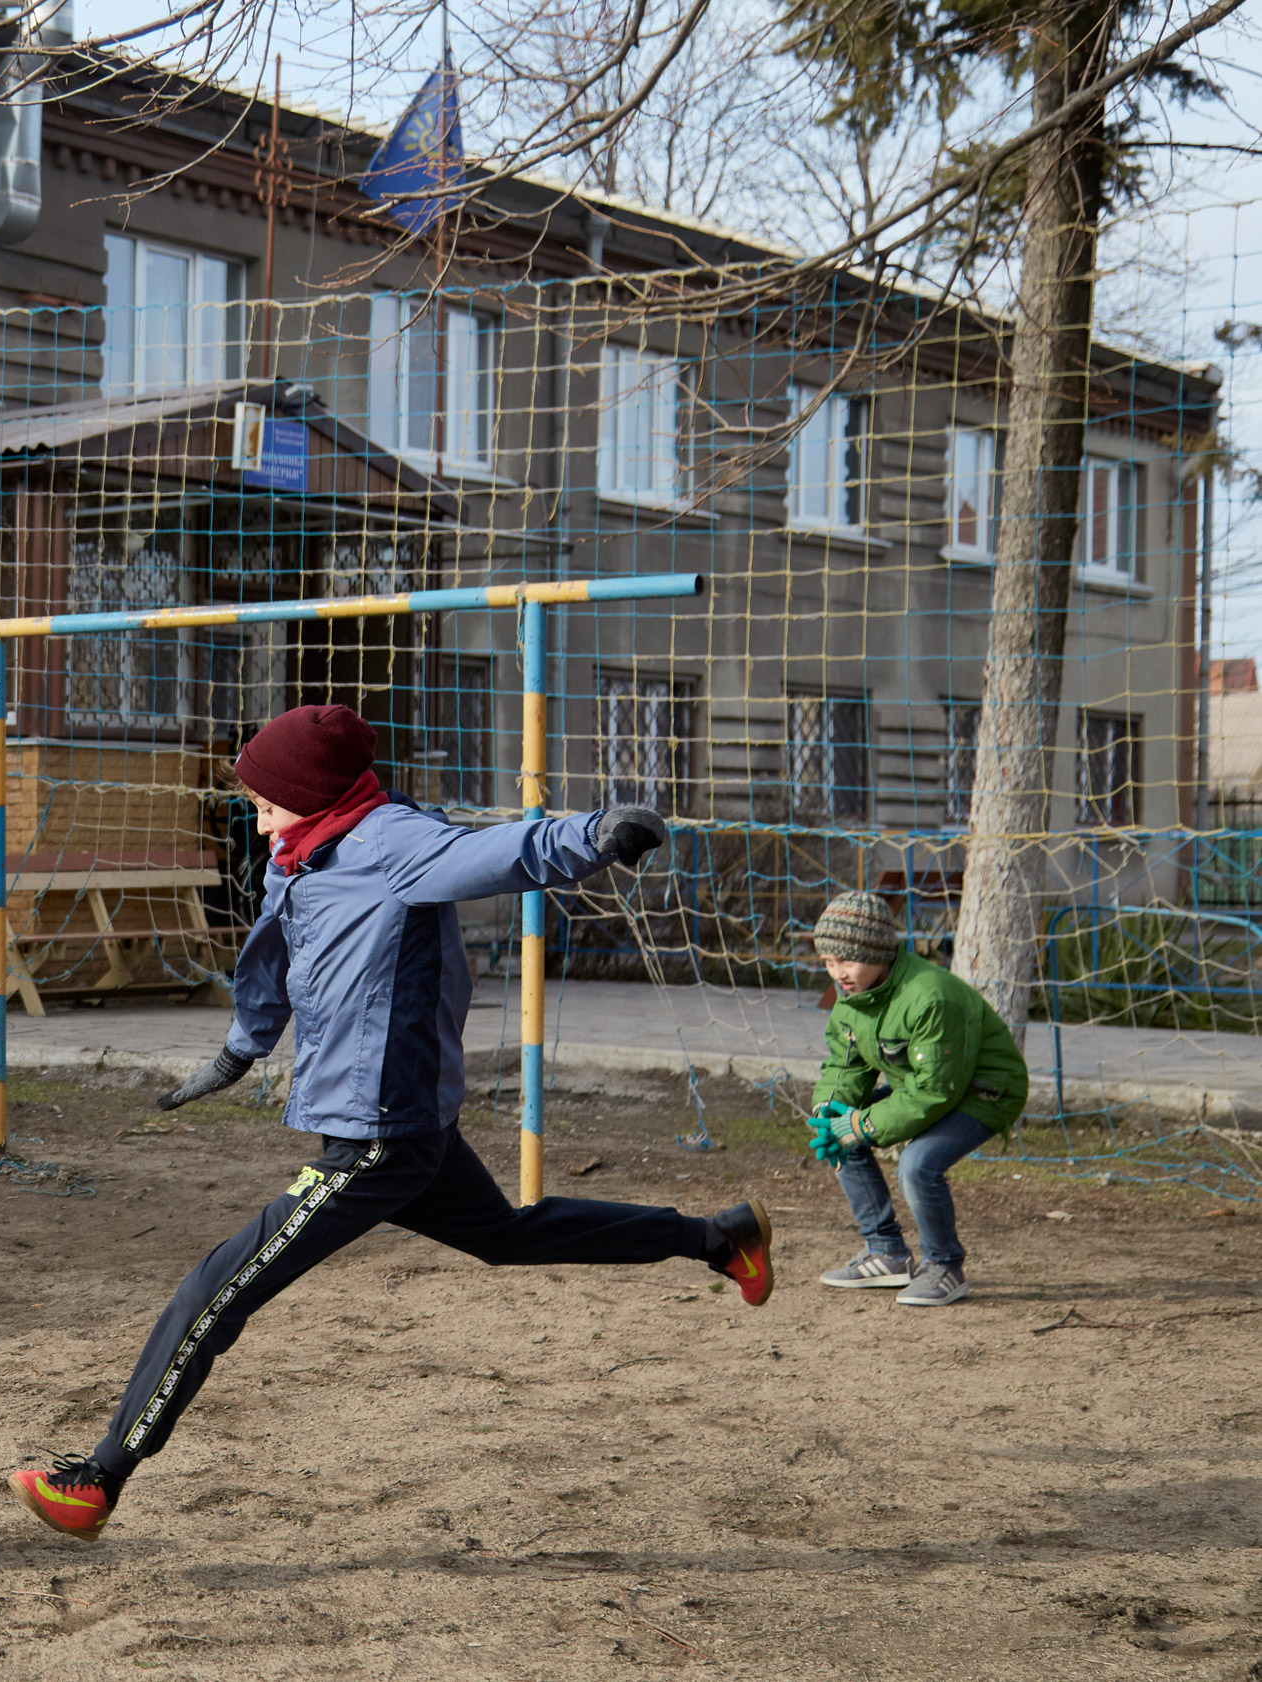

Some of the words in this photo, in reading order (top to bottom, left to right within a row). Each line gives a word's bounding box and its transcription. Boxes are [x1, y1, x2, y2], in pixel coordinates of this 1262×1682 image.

[365, 1138, 381, 1160] GOR
[305, 1183, 331, 1209] VIGOR
[283, 1208, 309, 1237] VIGOR
[259, 1235, 287, 1263] VIGOR
[235, 1262, 262, 1287] VIGOR
[211, 1285, 236, 1312] VIGOR
[191, 1314, 216, 1339] VIGOR
[176, 1341, 196, 1366] VIGOR
[159, 1369, 181, 1396] VIGOR
[143, 1397, 165, 1424] VIGOR
[126, 1423, 148, 1450] VIGOR
